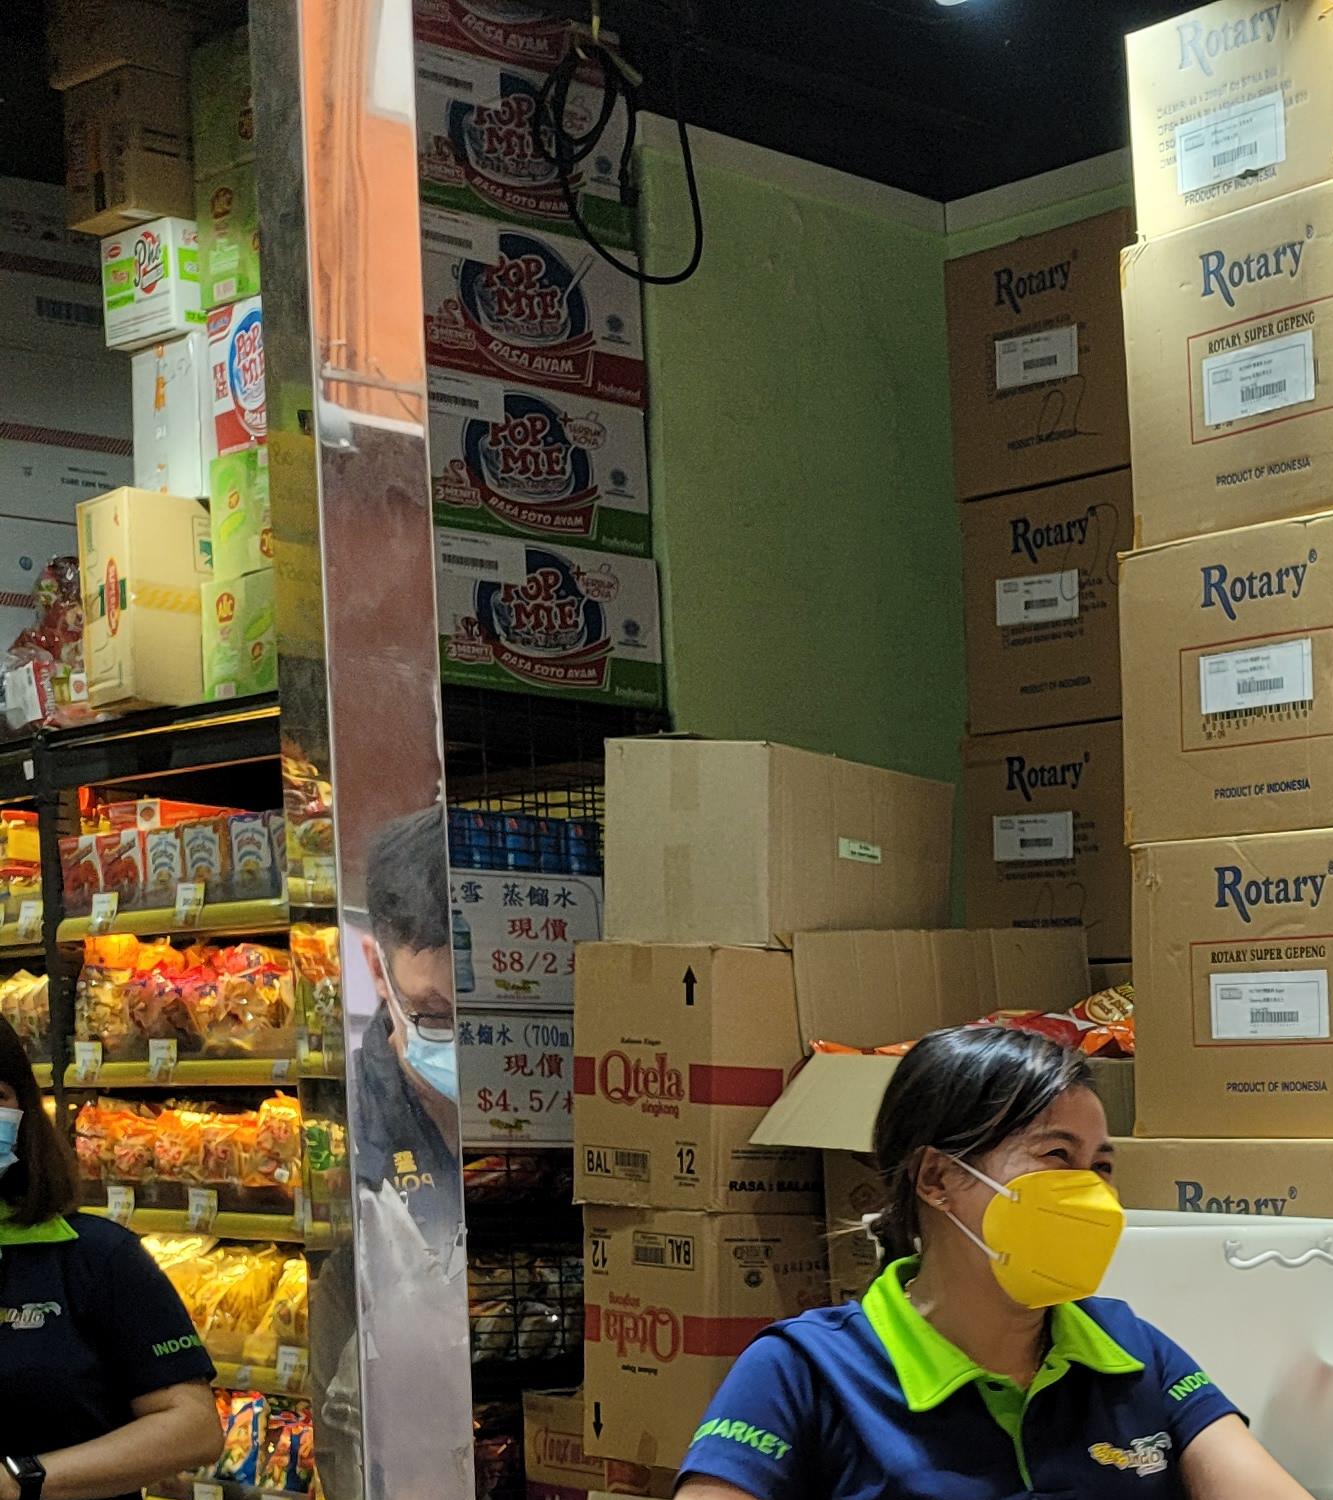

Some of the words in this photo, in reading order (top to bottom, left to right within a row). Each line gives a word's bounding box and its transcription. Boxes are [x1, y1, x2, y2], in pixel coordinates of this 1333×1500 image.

[1177, 2, 1282, 77] Rotary
[1184, 188, 1226, 208] PRODUCT
[993, 260, 1071, 315] Rotary
[1199, 240, 1305, 307] Rotary
[494, 285, 562, 322] MIE
[1207, 329, 1243, 355] ROTARY
[1244, 321, 1275, 345] SUPER
[1276, 310, 1316, 334] GEPENG
[489, 340, 529, 367] RASA
[532, 352, 575, 374] AYAM
[499, 443, 569, 479] MIE
[1215, 468, 1253, 487] PRODUCT
[1254, 464, 1265, 479] OF
[1266, 455, 1311, 476] INDONESIA
[488, 495, 519, 517] RASA
[520, 507, 552, 526] SOTO
[553, 514, 584, 528] AYAM
[1009, 515, 1090, 564] Rotary
[1199, 563, 1308, 621] Rotary
[512, 598, 582, 633] MIE
[502, 652, 532, 672] RASA
[533, 662, 564, 679] SOTO
[565, 667, 598, 681] AYAM
[1006, 756, 1084, 801] Rotary
[1214, 783, 1252, 800] PRODUCT
[1254, 782, 1266, 797] OF
[1266, 777, 1311, 795] INDONESIA
[1214, 865, 1327, 924] Rotary
[507, 916, 569, 943] 現價
[1210, 950, 1248, 963] ROTARY
[1249, 948, 1283, 962] SUPER
[1284, 945, 1327, 960] GEPENG
[503, 1052, 563, 1079] 現價
[599, 1049, 686, 1106] Qtela
[1226, 1081, 1265, 1093] PRODUCT
[1268, 1081, 1279, 1092] OF
[1281, 1079, 1328, 1093] INDONESIA
[641, 1100, 680, 1119] singkong
[586, 1149, 611, 1174] BAL
[676, 1147, 696, 1175] 12
[729, 1181, 766, 1192] RASA
[1174, 1180, 1288, 1217] Rotary
[592, 1239, 609, 1269] 12
[668, 1238, 691, 1266] BAL
[603, 1304, 681, 1364] Qtela
